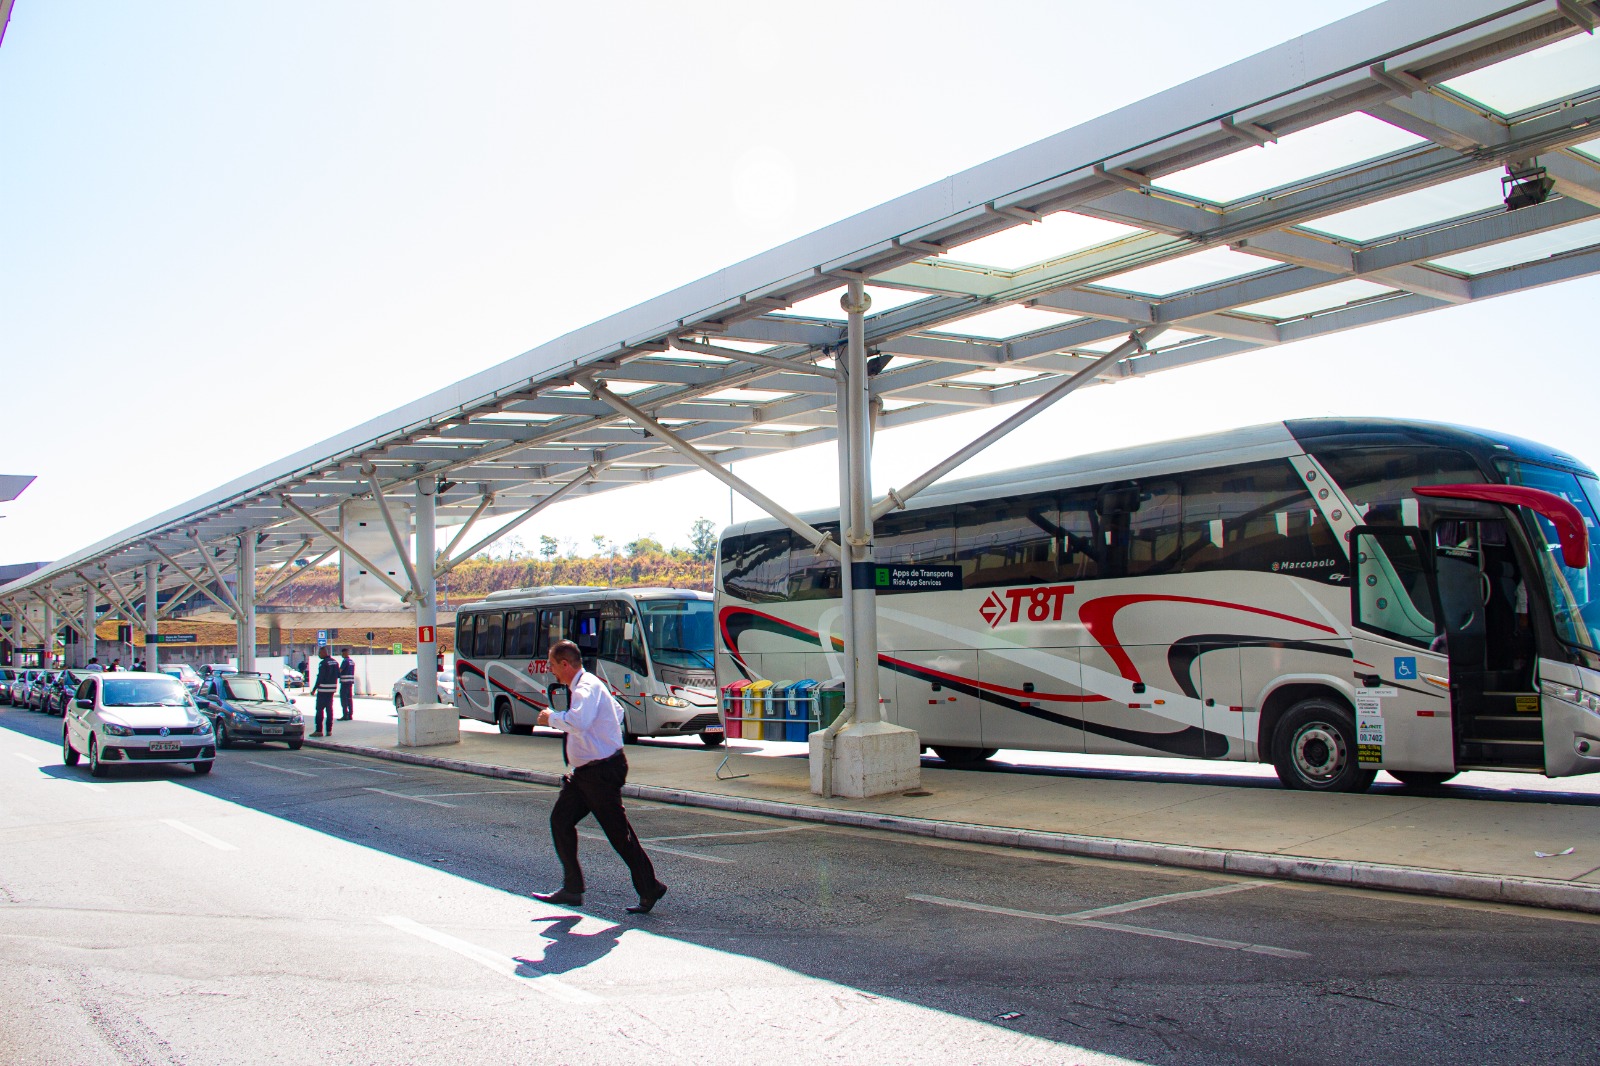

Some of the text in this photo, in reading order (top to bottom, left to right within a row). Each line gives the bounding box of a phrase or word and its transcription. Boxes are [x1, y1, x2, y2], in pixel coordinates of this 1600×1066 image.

[1281, 559, 1335, 570] Marcopolo
[892, 568, 954, 578] Apps de Transporte
[892, 578, 942, 587] Ride App Services
[535, 660, 548, 673] T8
